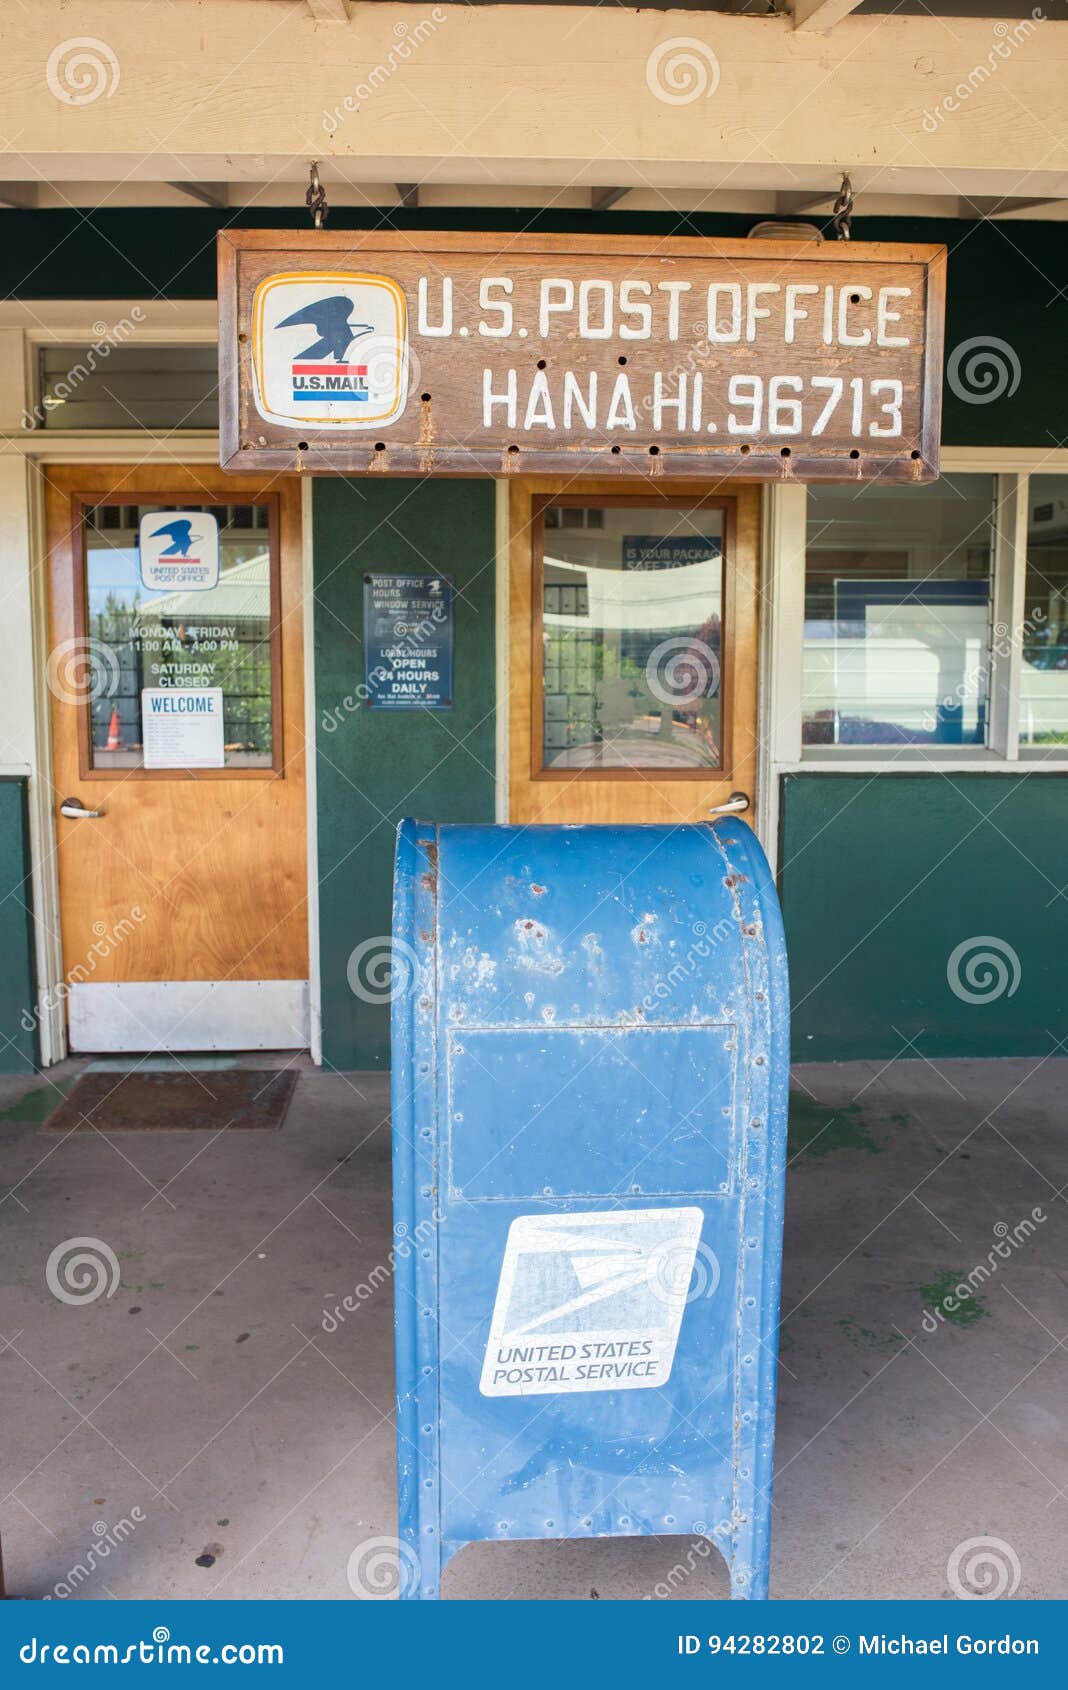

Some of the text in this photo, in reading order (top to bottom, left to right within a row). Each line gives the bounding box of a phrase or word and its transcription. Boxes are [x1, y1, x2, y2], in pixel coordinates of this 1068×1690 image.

[707, 282, 912, 347] OFFICE
[483, 368, 637, 431] HANA
[641, 549, 671, 559] YOUR
[150, 567, 210, 575] UNITED STATES
[154, 575, 206, 583] POST OFFICE
[373, 580, 424, 588] POST OFFICE
[373, 589, 401, 598] HOURS
[374, 600, 446, 609] WINDOW SERVICE
[129, 626, 180, 638] MONDAY
[192, 626, 237, 638] FRIDAY
[129, 640, 159, 652] 11:00
[162, 640, 181, 652] AM
[192, 640, 217, 652] 4:00
[220, 640, 239, 652] PM
[151, 663, 216, 675] SATURDAY
[393, 659, 426, 669] OPEN
[379, 671, 439, 681] 24 HOURS
[159, 676, 210, 688] CLOSED
[392, 683, 427, 693] DAILY
[151, 696, 214, 713] WELCOME
[497, 1340, 654, 1364] UNITED STATES
[493, 1361, 659, 1385] POSTAL SERVICE
